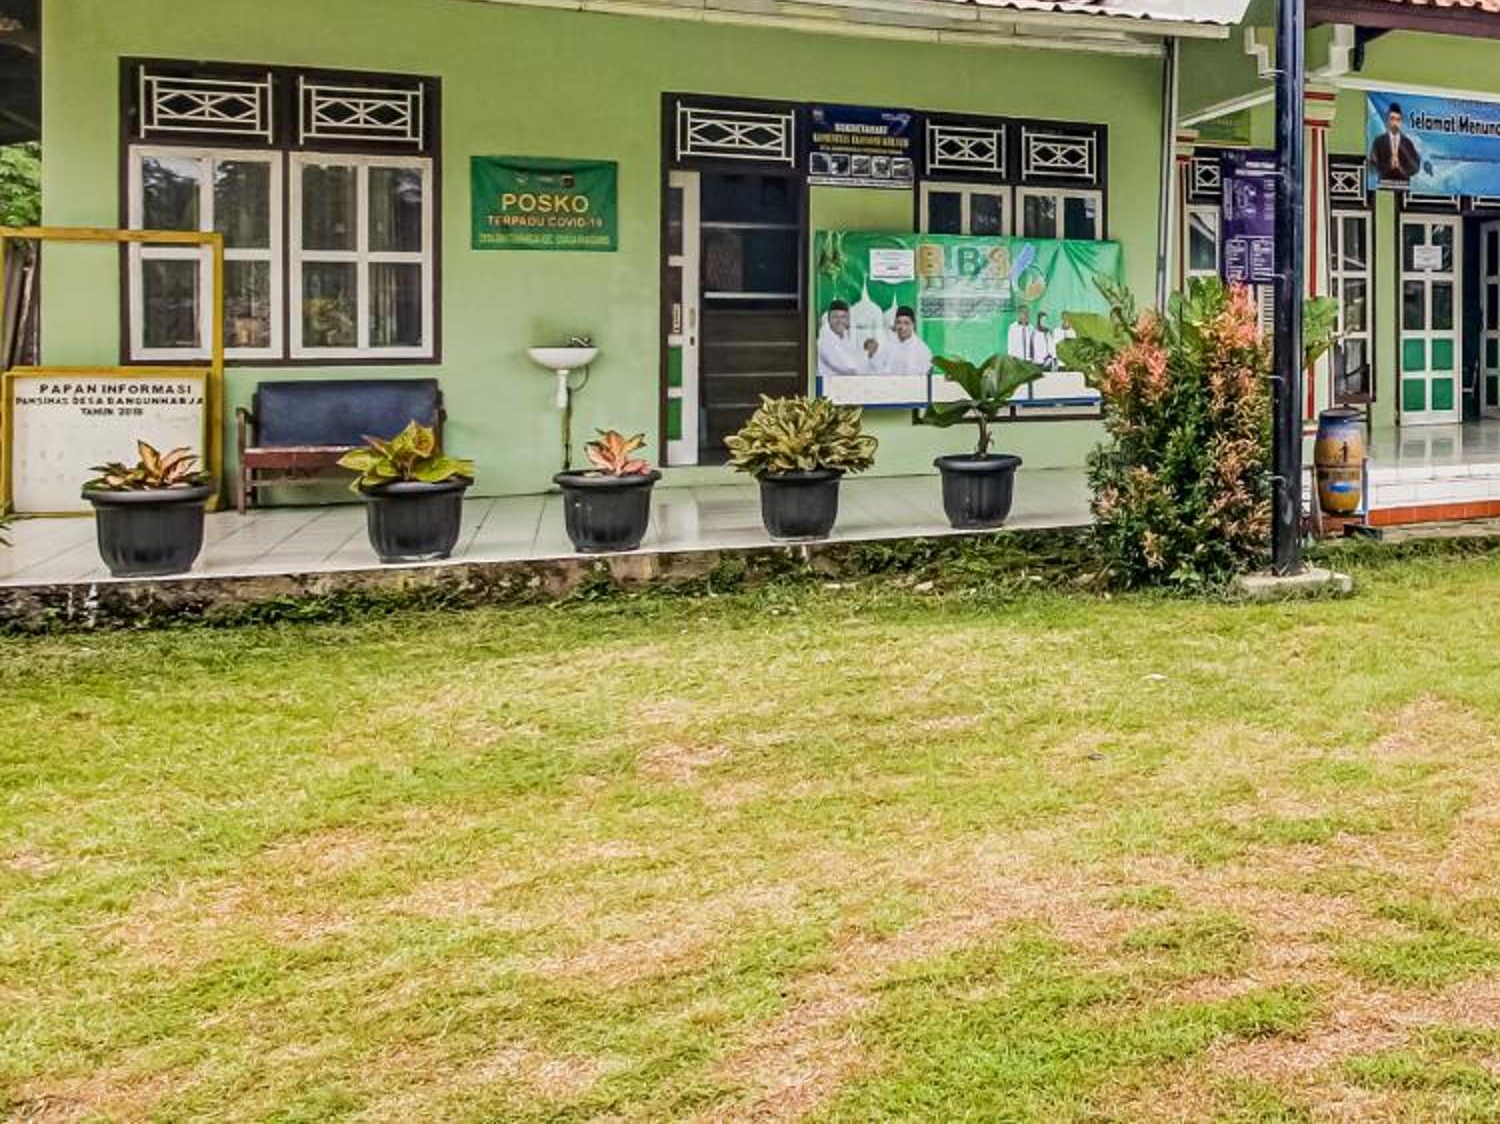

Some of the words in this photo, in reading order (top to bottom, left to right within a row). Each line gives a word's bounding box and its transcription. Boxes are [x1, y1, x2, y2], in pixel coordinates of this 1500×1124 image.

[1408, 110, 1456, 133] Selamat
[501, 192, 590, 214] POSKO
[488, 214, 545, 227] TERPADU
[39, 383, 97, 395] PAPAN
[101, 383, 192, 395] INFORMASI
[72, 396, 104, 406] DESA
